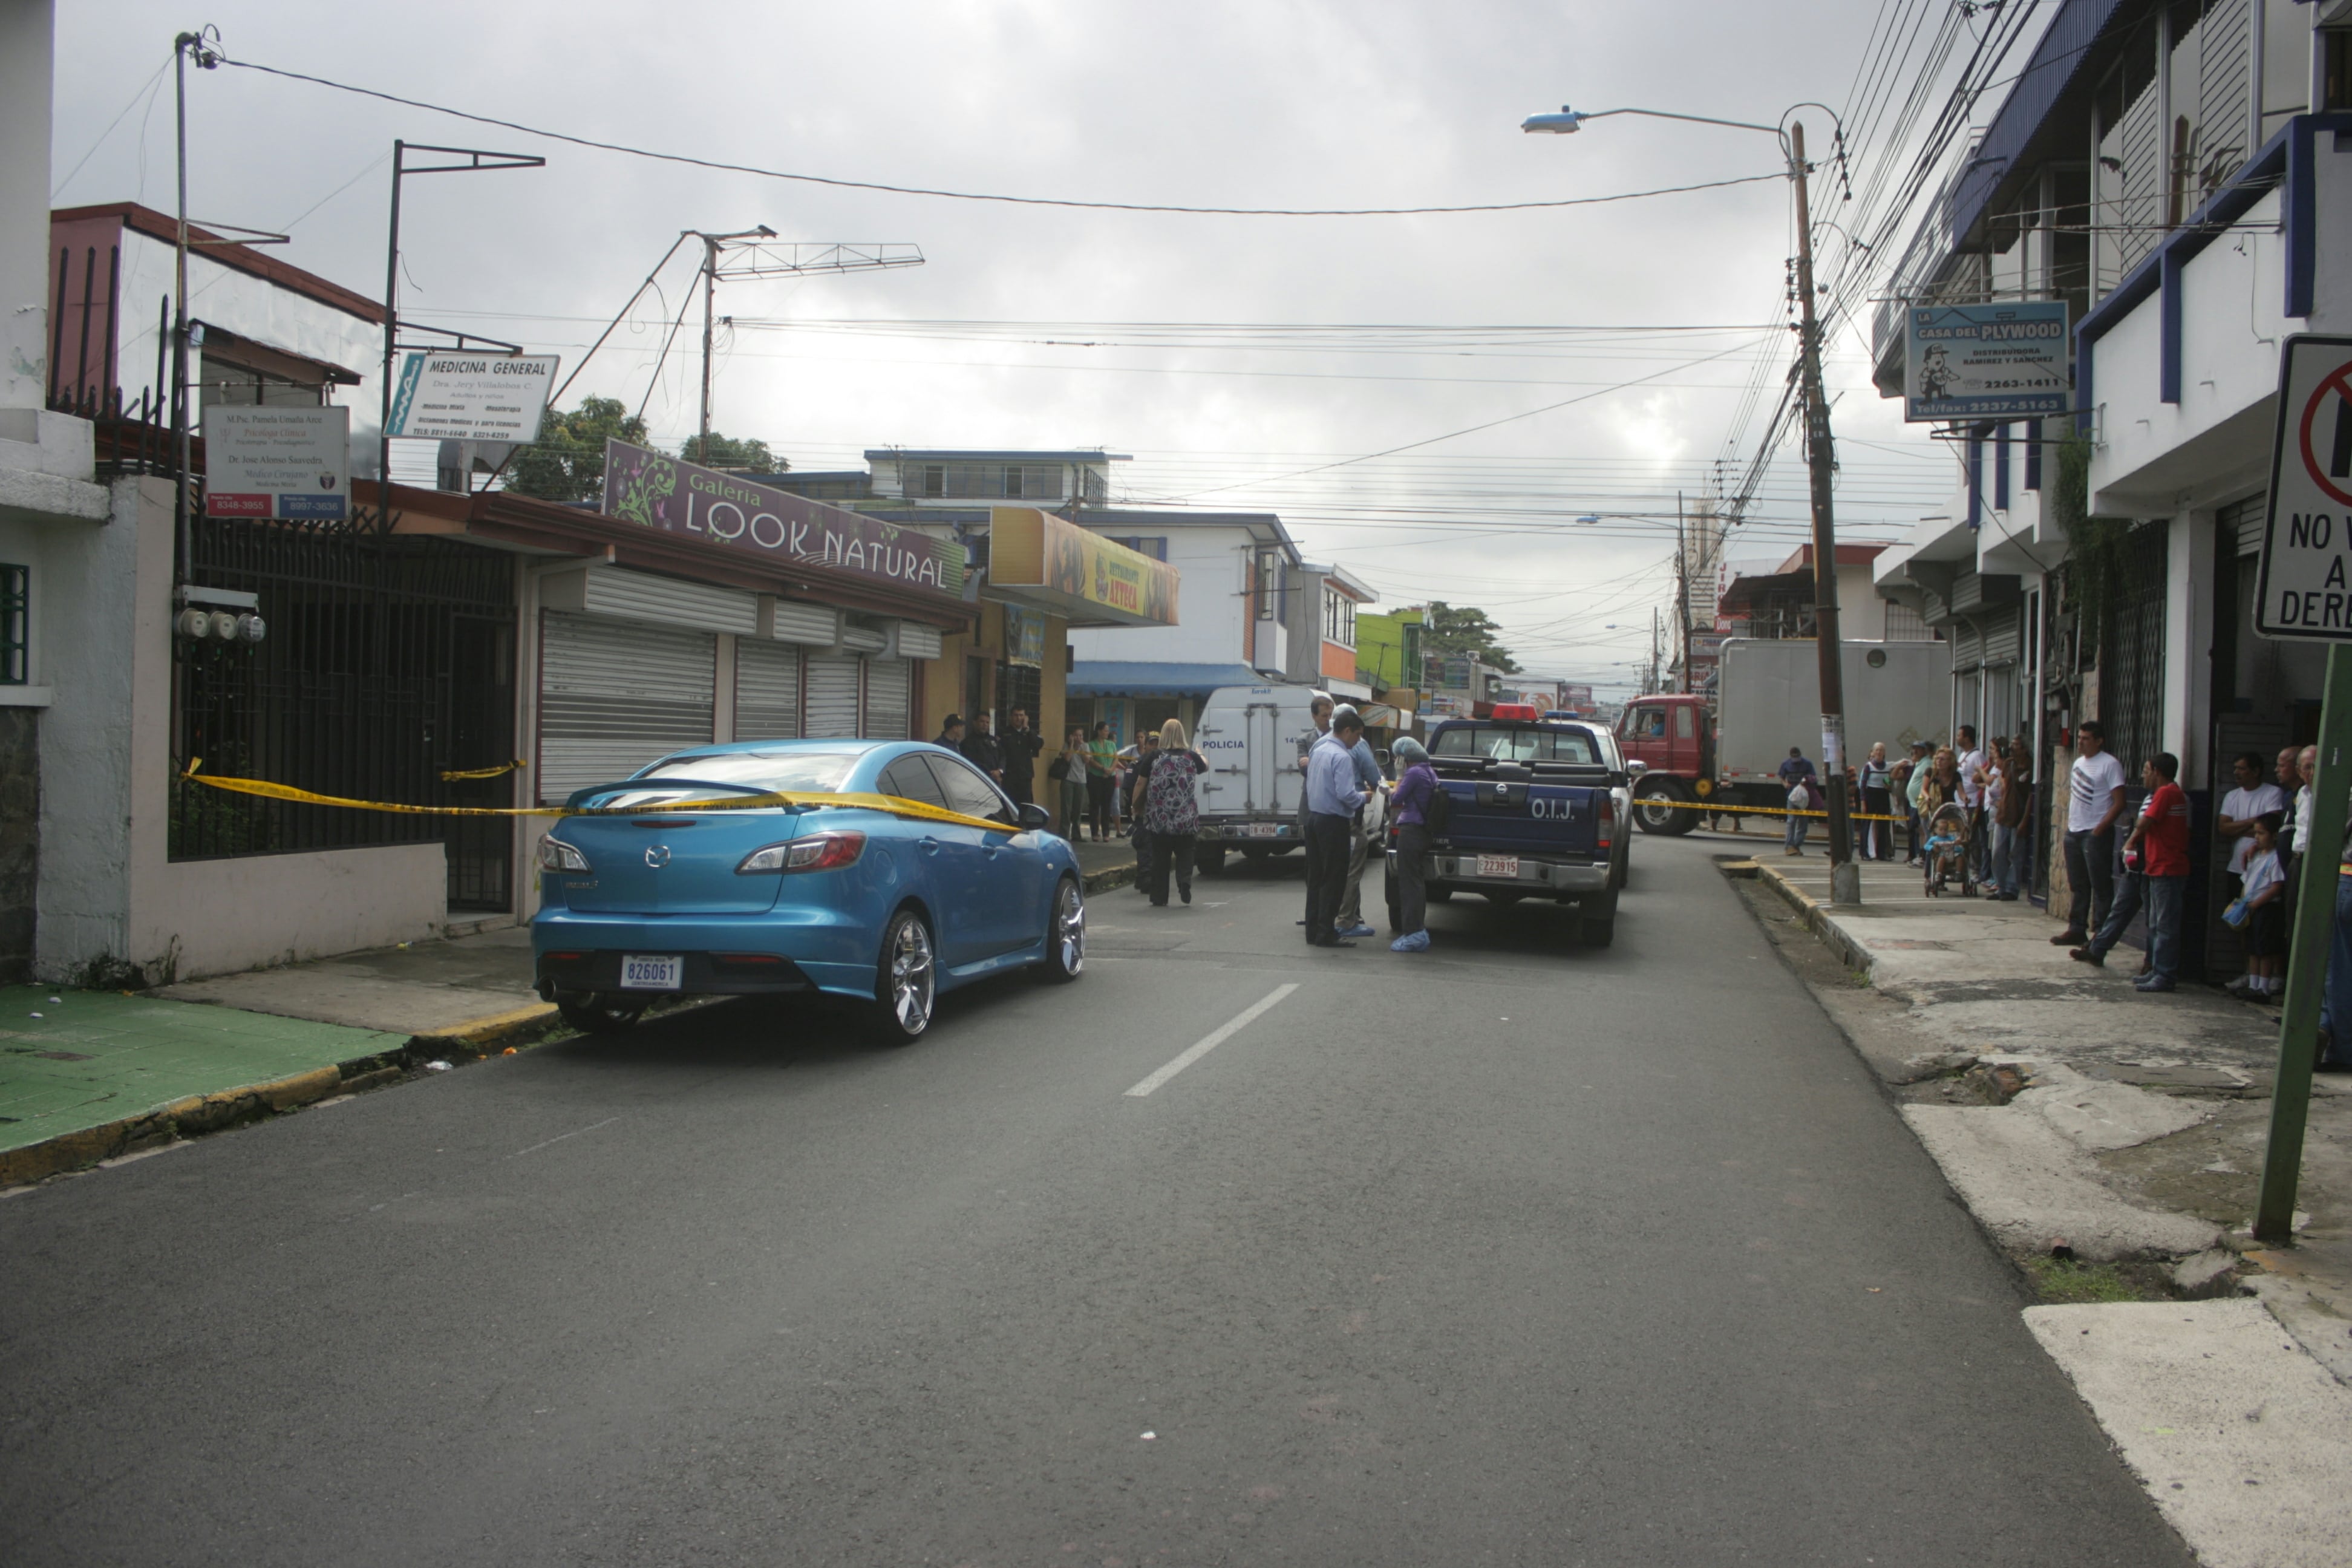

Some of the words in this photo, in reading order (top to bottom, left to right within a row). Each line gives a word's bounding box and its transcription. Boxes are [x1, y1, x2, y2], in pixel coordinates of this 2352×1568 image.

[1917, 313, 1930, 322] LA
[1918, 329, 1952, 339] CASA
[1955, 327, 1978, 338] DEL
[1980, 322, 2062, 341] PLYWOOD
[1973, 347, 2040, 356] DISTRIBUIDORA
[1963, 356, 2002, 365] RAMIREZ
[429, 361, 486, 373] MEDICINA
[493, 362, 546, 375] GENERAL
[433, 380, 451, 388] Dra.
[477, 381, 521, 390] Villalobos
[1984, 378, 2059, 388] 2263-1411
[1915, 404, 1967, 414] Tel/fax:
[1970, 400, 2058, 412] 2237-5163
[252, 415, 278, 424] Pamela
[305, 416, 322, 424] Arce
[261, 455, 287, 465] Alonso
[288, 455, 322, 465] Saavedra
[688, 473, 762, 508] Galeria
[217, 500, 264, 509] 8348-3955
[290, 502, 339, 511] 8997-3636
[2289, 512, 2331, 549] NO
[685, 492, 808, 557] LOOK
[823, 529, 947, 589] NATURAL
[2324, 554, 2347, 590] A
[1109, 578, 1137, 610] AZTECA
[1202, 740, 1245, 749] POLICIA
[1531, 798, 1575, 820] O.I.J.
[1484, 860, 1516, 872] 223915
[627, 962, 674, 981] 826061
